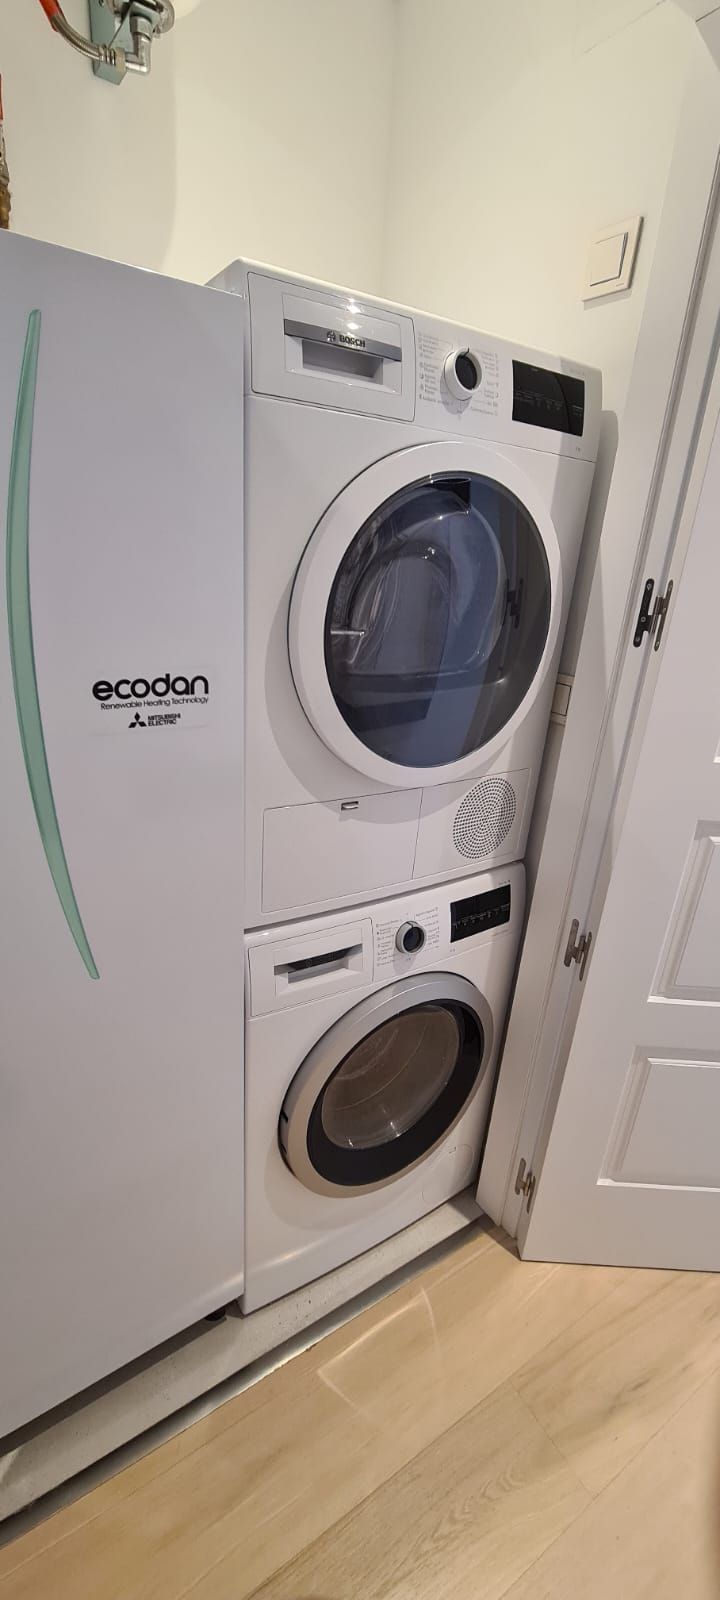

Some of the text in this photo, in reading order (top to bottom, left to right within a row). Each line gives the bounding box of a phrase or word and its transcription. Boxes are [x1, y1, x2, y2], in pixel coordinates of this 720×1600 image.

[339, 334, 366, 348] BOSCH
[92, 673, 209, 701] ecodan
[100, 696, 209, 710] Renewable Heating Technology
[147, 718, 177, 727] ELECTRIC
[148, 713, 181, 721] MITSUBISHI
